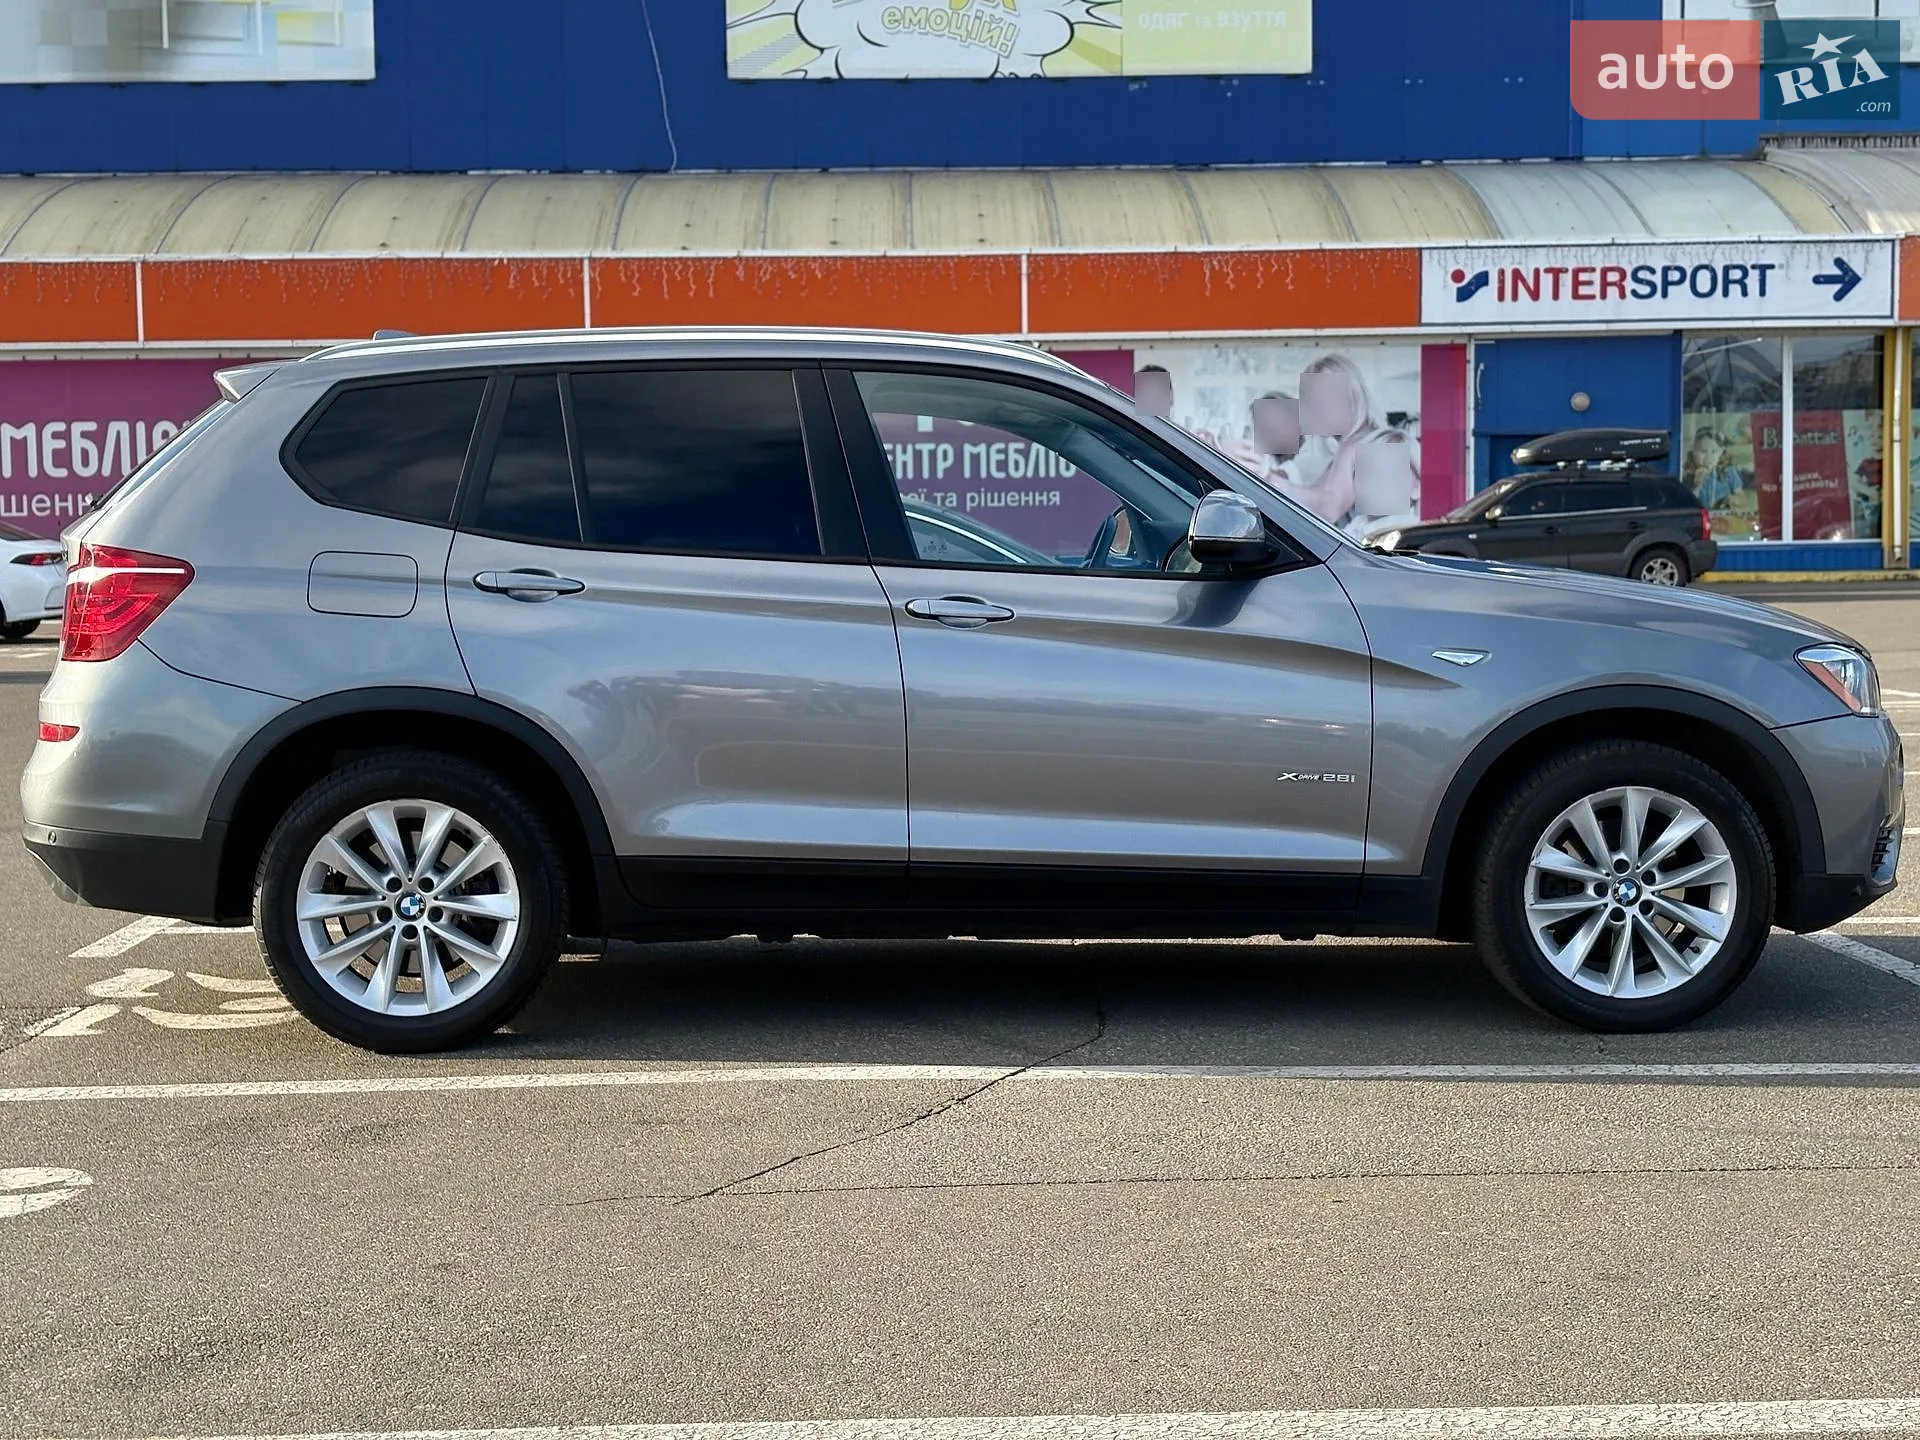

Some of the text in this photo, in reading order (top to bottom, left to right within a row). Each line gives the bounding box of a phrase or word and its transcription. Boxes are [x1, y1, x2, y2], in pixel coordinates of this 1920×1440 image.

[881, 7, 1017, 54] емоцій!
[1138, 12, 1188, 31] ОДЯГ
[1217, 10, 1286, 31] ВЗУТТЯ
[1496, 263, 1776, 302] INTERSPORT
[933, 491, 957, 508] та
[966, 487, 1061, 512] рішення
